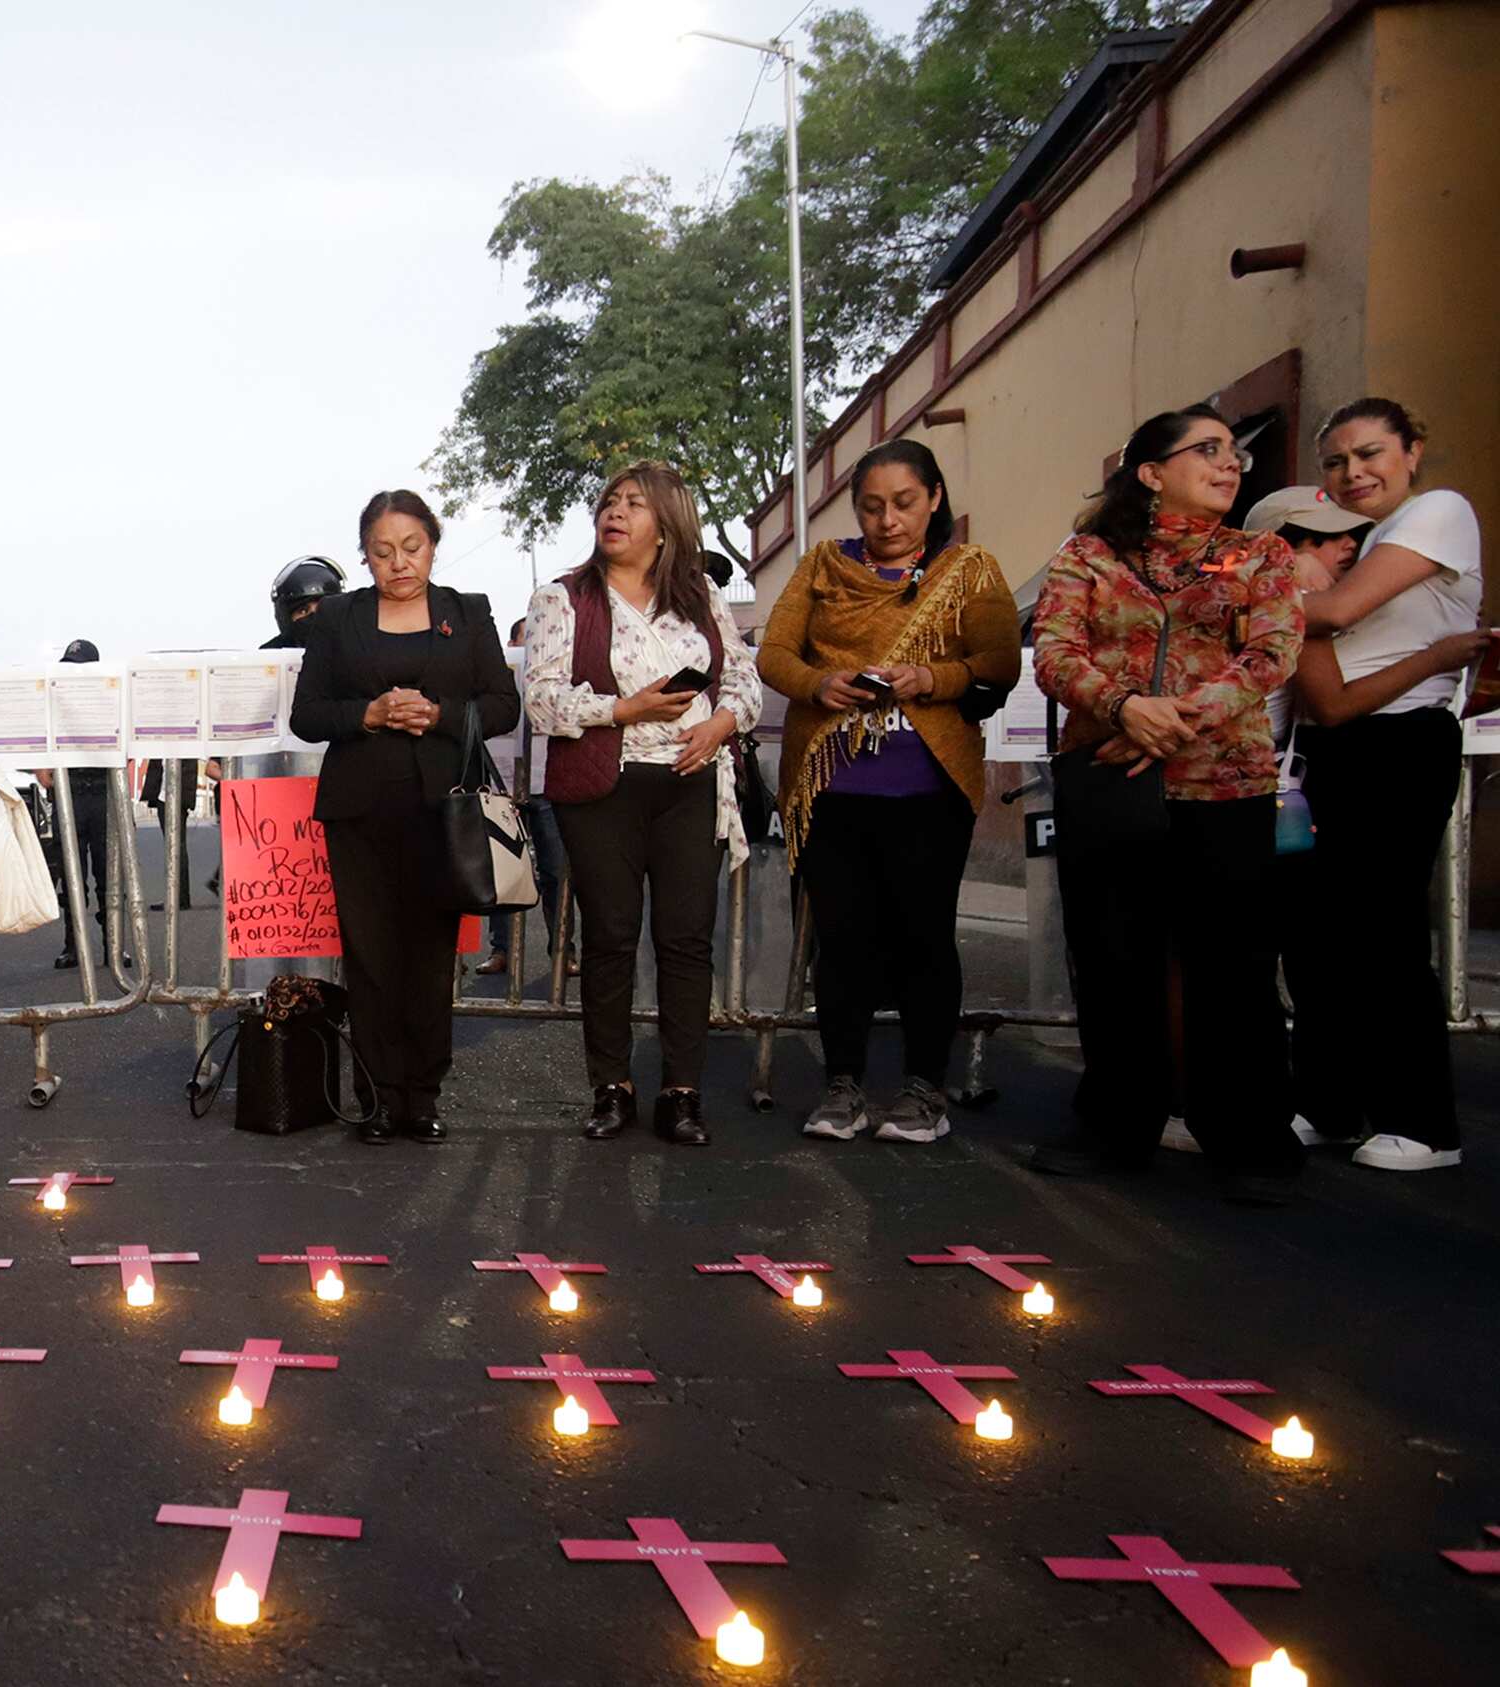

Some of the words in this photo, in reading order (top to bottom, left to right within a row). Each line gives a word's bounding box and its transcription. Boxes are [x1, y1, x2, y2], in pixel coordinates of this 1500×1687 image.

[231, 784, 277, 851] No
[281, 1254, 373, 1262] ASESINADAS
[230, 1513, 283, 1526] Paola
[636, 1544, 703, 1557] Mayra
[1143, 1565, 1199, 1578] Irene
